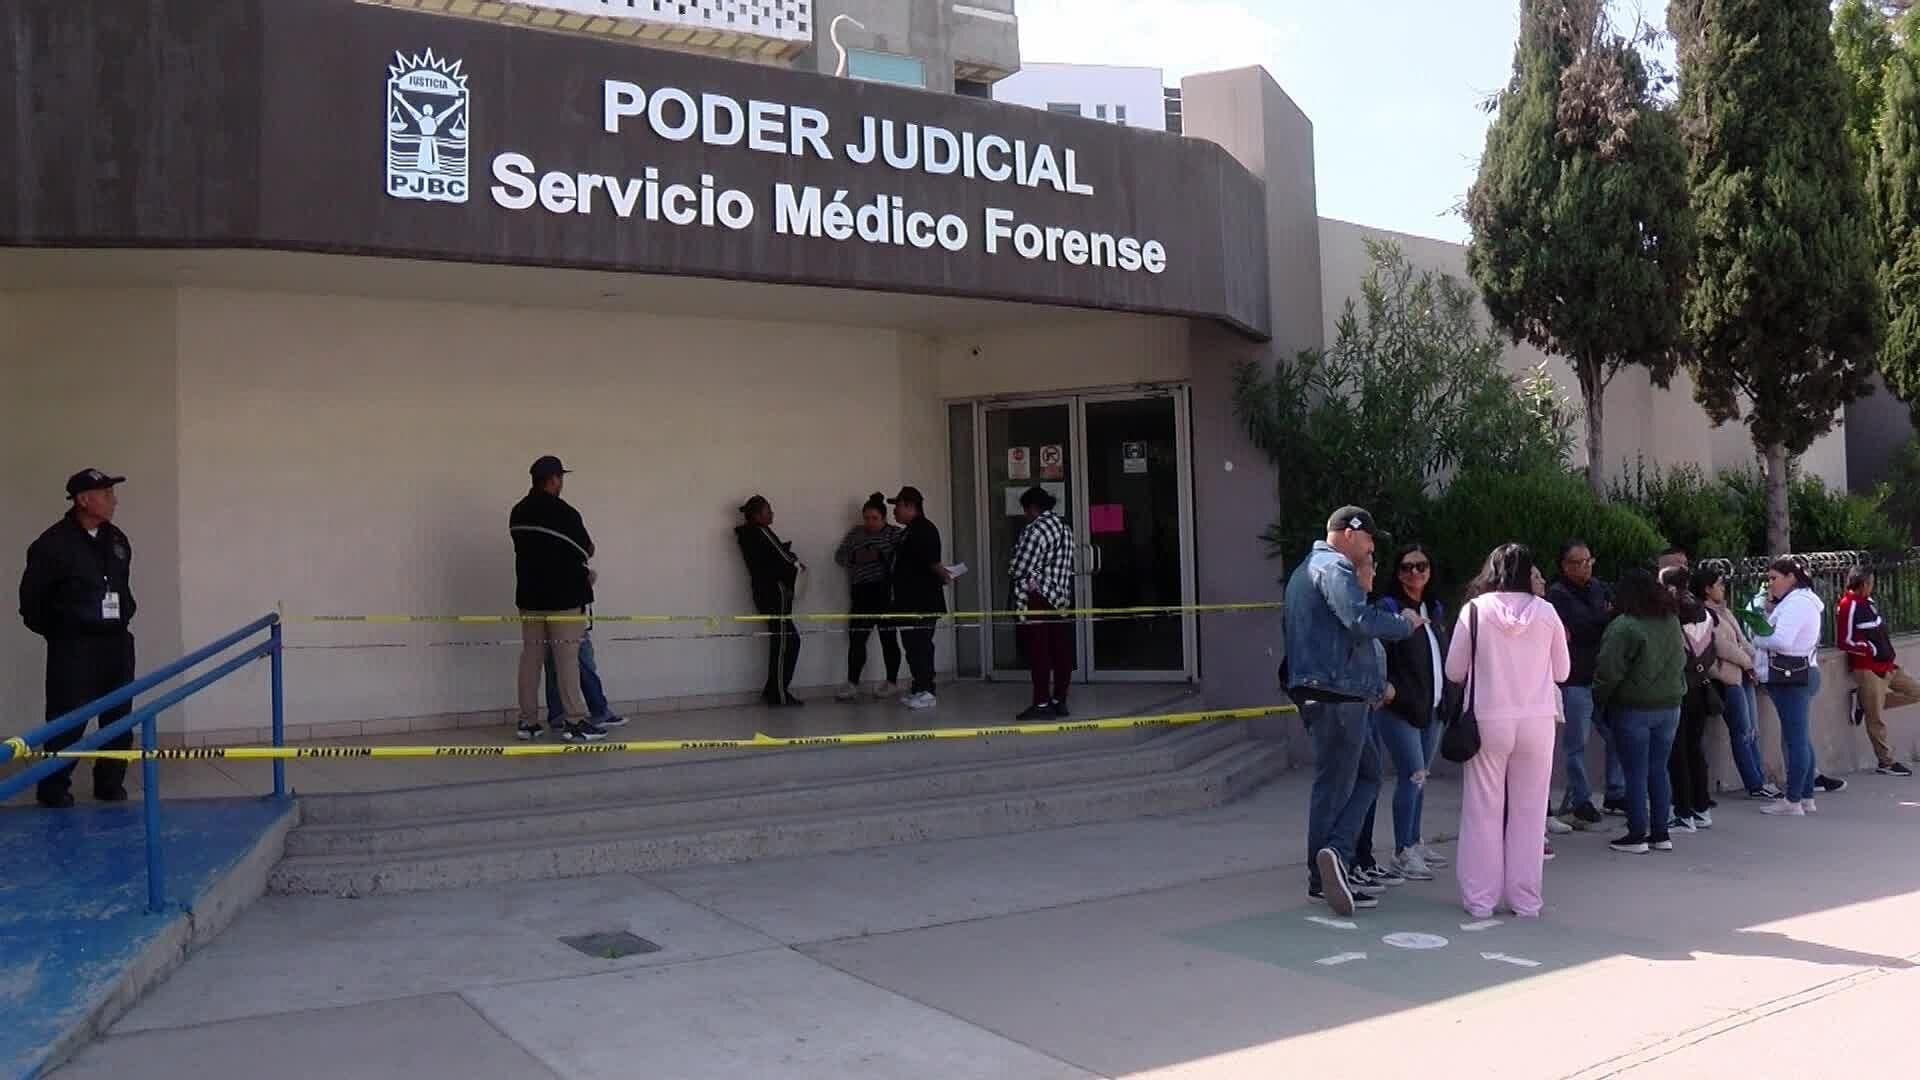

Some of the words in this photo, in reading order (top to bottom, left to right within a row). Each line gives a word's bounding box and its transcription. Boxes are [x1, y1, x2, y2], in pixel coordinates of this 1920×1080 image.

[391, 174, 465, 196] PJBC
[604, 80, 833, 159] PODER
[846, 116, 1093, 195] JUDICIAL
[491, 152, 754, 230] Servicio
[775, 184, 967, 251] Médico
[985, 208, 1167, 273] Forense
